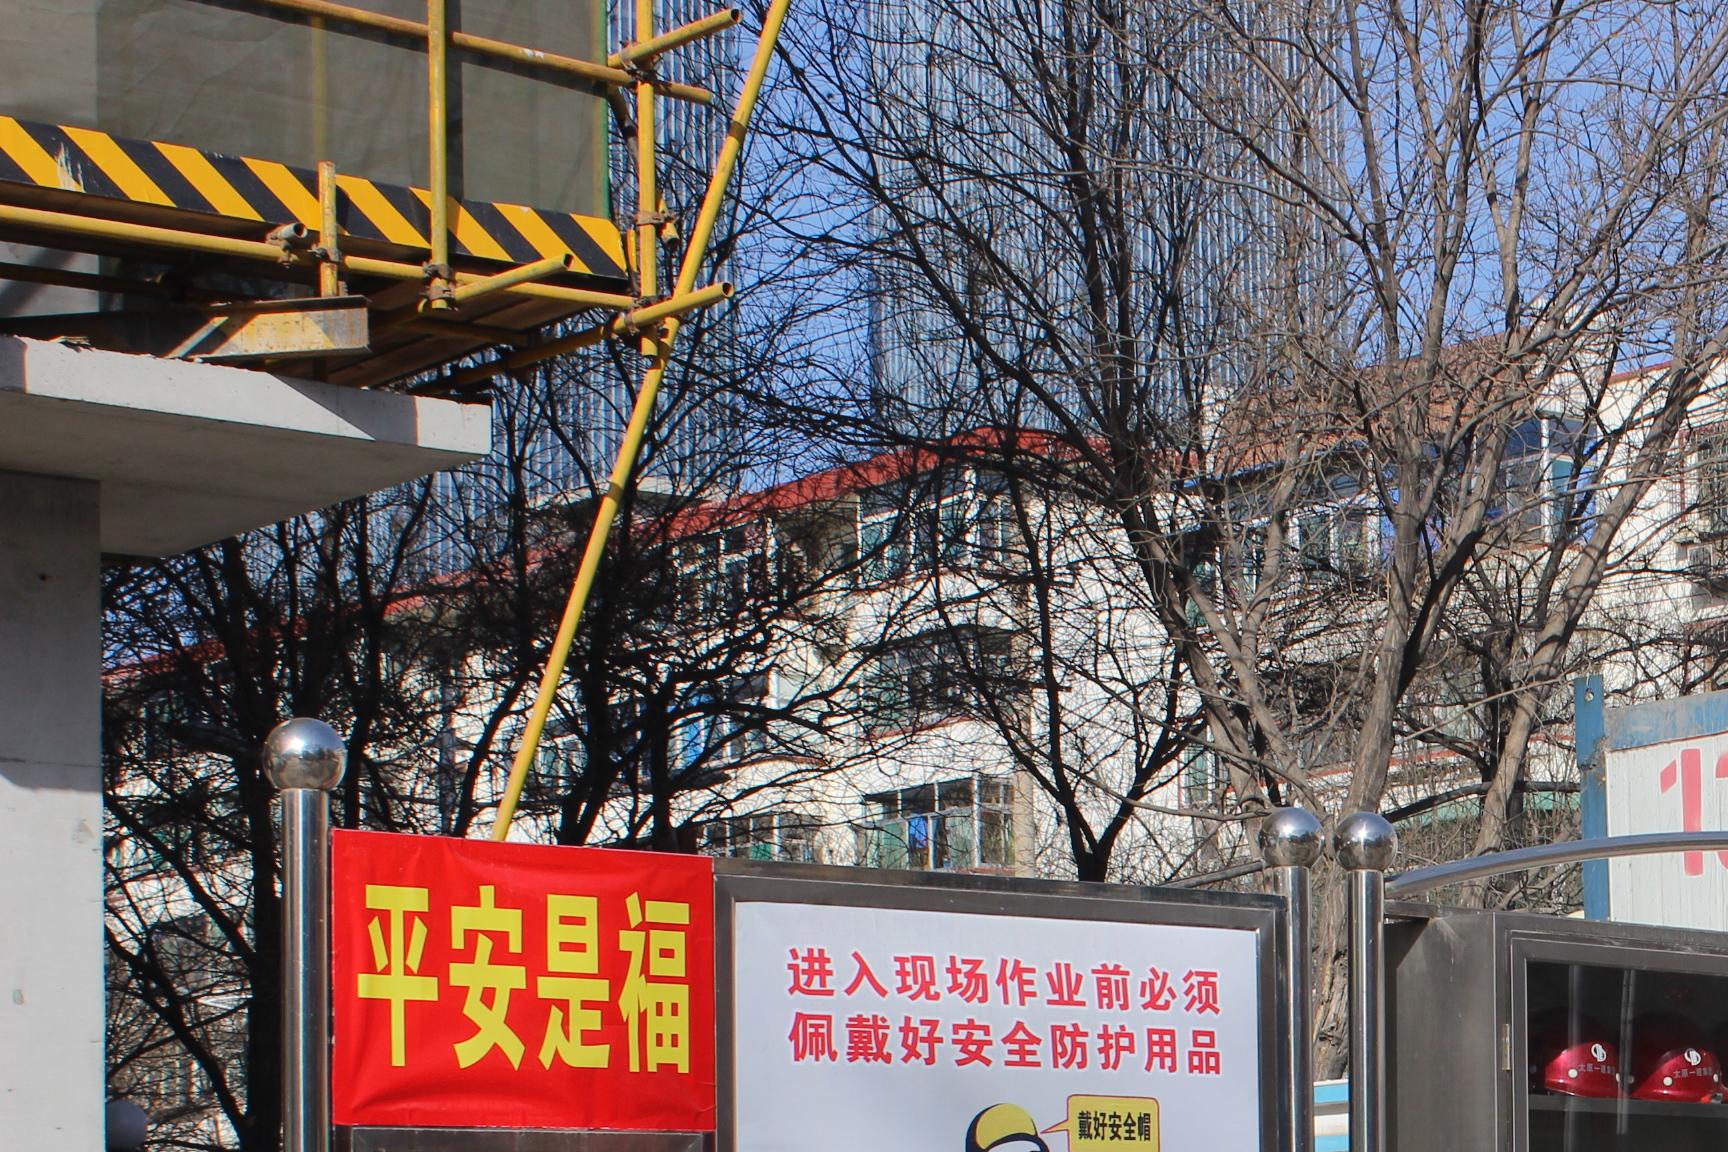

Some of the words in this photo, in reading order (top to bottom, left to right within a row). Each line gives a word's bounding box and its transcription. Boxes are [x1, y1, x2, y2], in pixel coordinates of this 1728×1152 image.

[357, 884, 690, 1074] 平安是福
[787, 947, 1220, 1016] 进入现场作业前必须
[788, 1011, 1222, 1075] 佩戴好安全防护用品
[1078, 1110, 1151, 1142] 戴好安全帽
